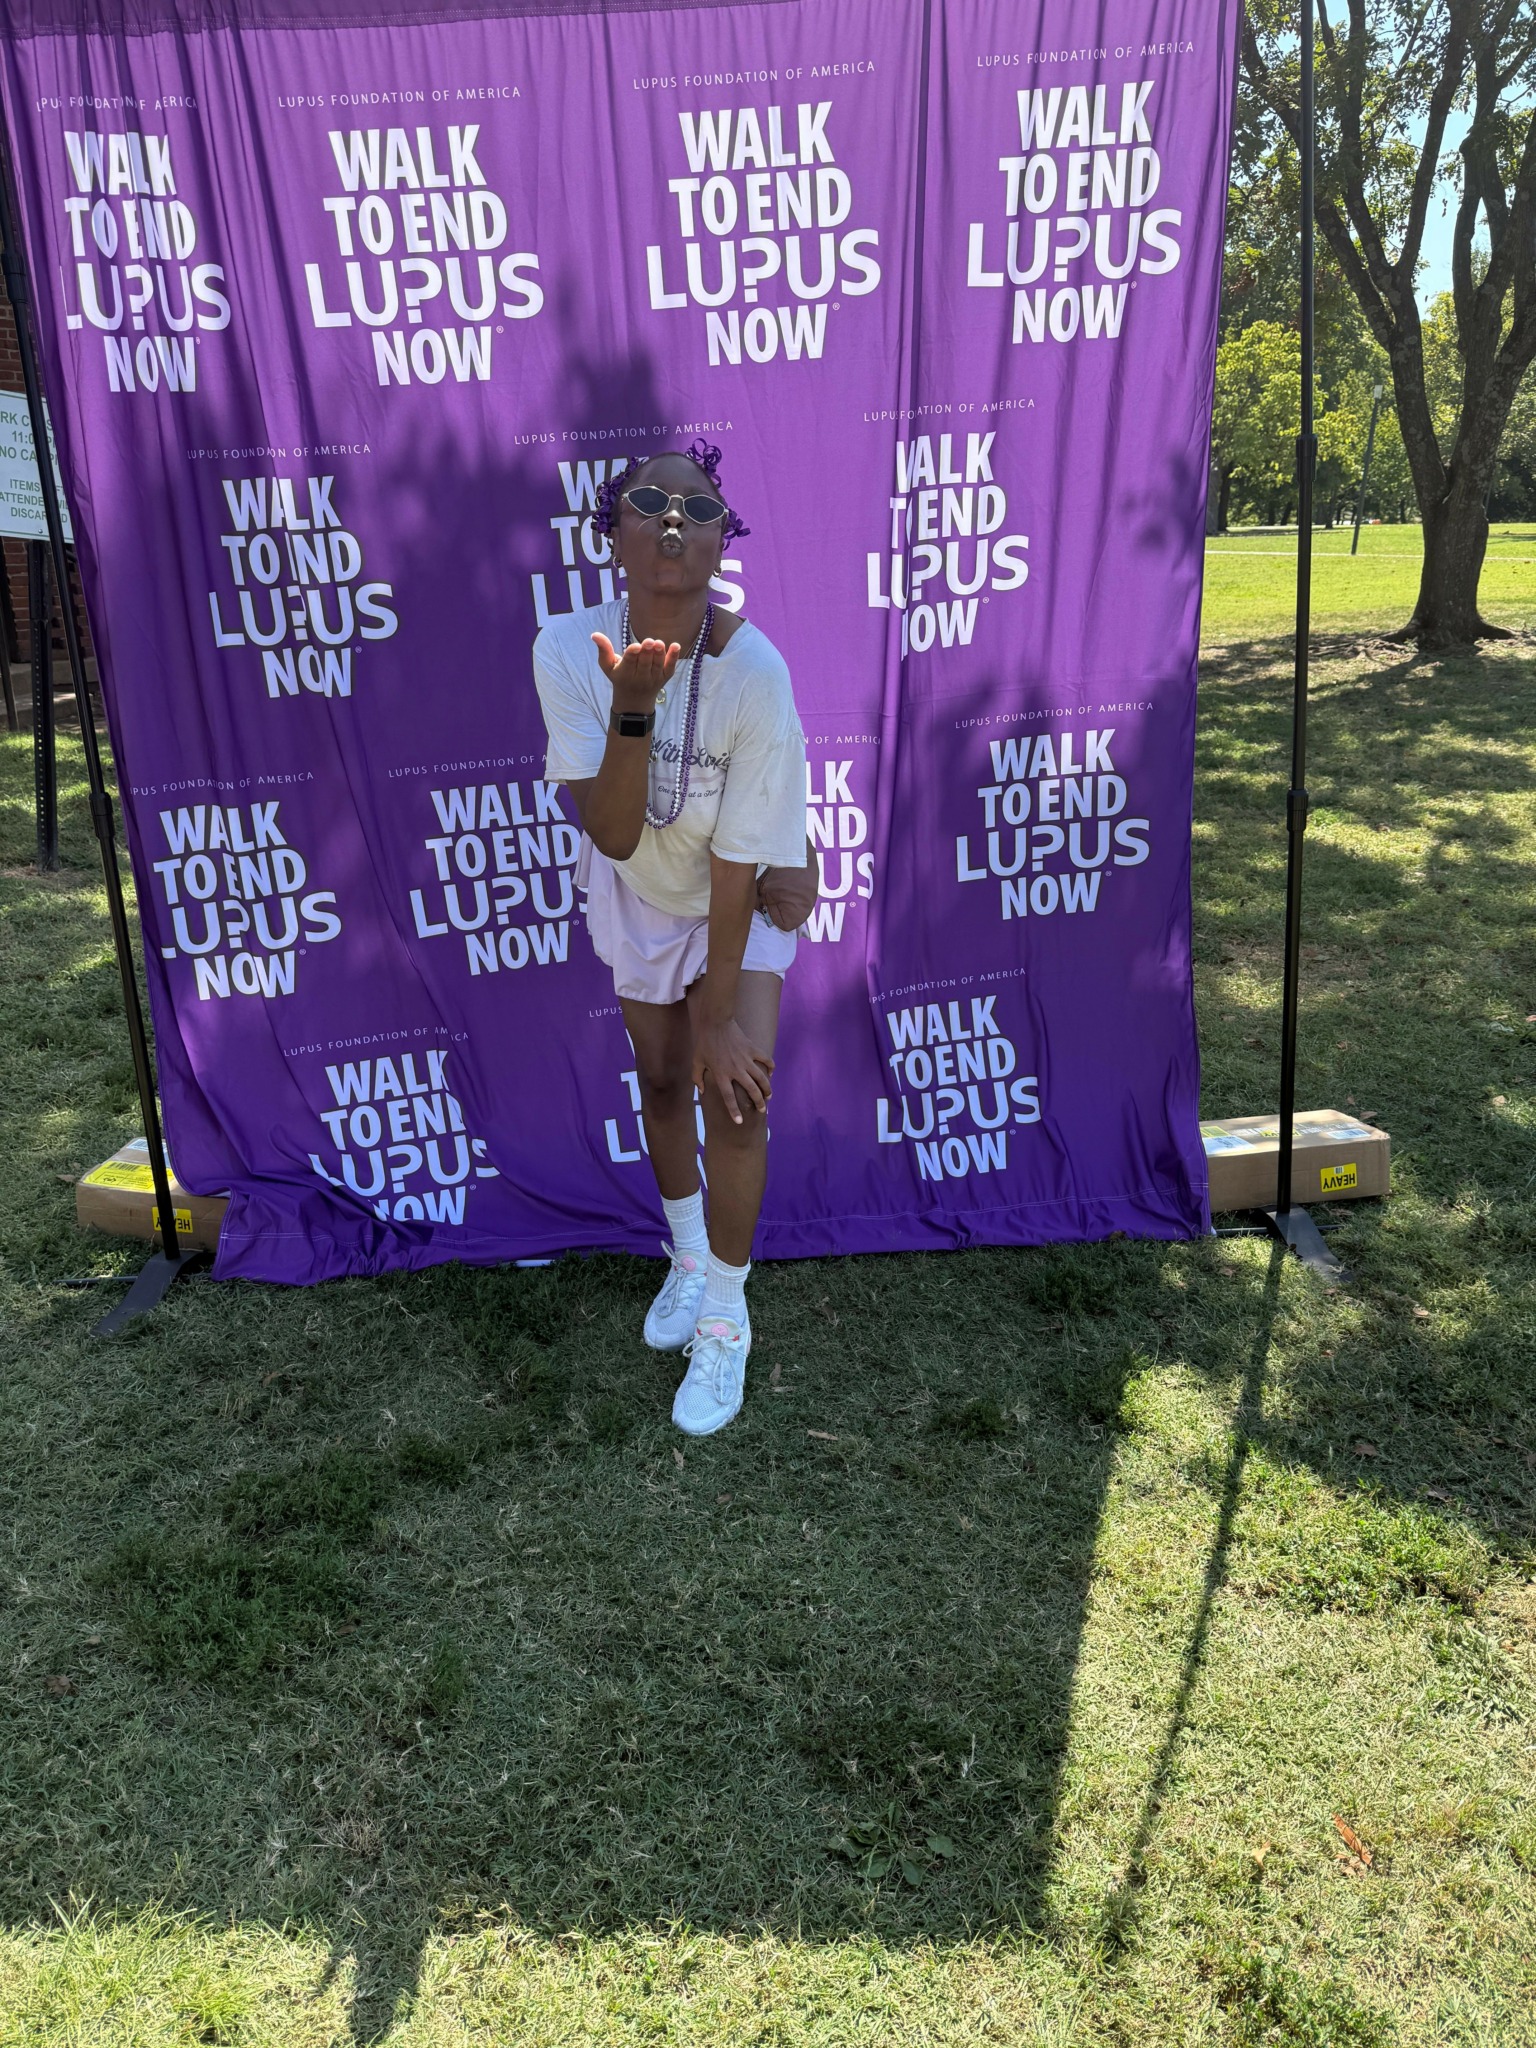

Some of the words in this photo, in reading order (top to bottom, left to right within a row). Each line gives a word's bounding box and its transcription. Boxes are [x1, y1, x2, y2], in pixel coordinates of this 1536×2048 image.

[634, 77, 677, 90] LUPUS
[685, 70, 778, 87] FOUNDATION
[786, 68, 802, 79] OF
[811, 61, 875, 77] AMERICA
[977, 55, 1019, 67] LUPUS
[1027, 48, 1107, 64] FOUNDATION
[1115, 47, 1132, 58] OF
[1140, 42, 1194, 57] AMERICA
[278, 96, 324, 107] LUPUS
[331, 91, 424, 105] FOUNDATION
[432, 90, 450, 101] OF
[456, 87, 521, 100] AMERICA
[1017, 81, 1155, 151] WALK
[64, 130, 176, 196] WALK
[328, 125, 487, 191] WALK
[678, 101, 835, 173] WALK
[668, 176, 738, 237] TO
[746, 168, 852, 232] END
[999, 154, 1057, 216] TO
[1066, 147, 1160, 212] END
[64, 197, 118, 258] TO
[122, 199, 196, 260] END
[323, 195, 394, 256] TO
[400, 191, 507, 254] END
[959, 403, 974, 413] OF
[982, 399, 1035, 413] AMERICA
[294, 447, 309, 457] OF
[314, 444, 371, 456] AMERICA
[514, 433, 556, 445] LUPUS
[563, 427, 646, 441] FOUNDATION
[653, 426, 668, 435] OF
[675, 421, 733, 435] AMERICA
[10, 478, 40, 492] ITEMS
[222, 476, 342, 531] WALK
[918, 485, 1006, 540] END
[221, 533, 280, 585] TO
[285, 531, 361, 584] ND
[815, 736, 829, 744] OF
[956, 717, 990, 729] LUPUS
[996, 708, 1072, 723] FOUNDATION
[1078, 706, 1092, 714] OF
[1099, 702, 1153, 713] AMERICA
[240, 778, 251, 788] OF
[258, 772, 314, 784] AMERICA
[389, 766, 427, 778] LUPUS
[434, 758, 514, 772] FOUNDATION
[521, 756, 535, 764] OF
[990, 729, 1116, 782] WALK
[159, 801, 287, 855] WALK
[430, 780, 566, 833] WALK
[806, 806, 867, 848] ND
[978, 783, 1031, 828] TO
[1039, 775, 1127, 821] END
[153, 854, 217, 905] TO
[222, 849, 306, 900] END
[425, 834, 486, 882] TO
[492, 824, 582, 873] END
[890, 979, 956, 997] FOUNDATION
[961, 976, 974, 984] OF
[980, 968, 1025, 981] AMERICA
[284, 1044, 322, 1057] LUPUS
[329, 1030, 408, 1049] FOUNDATION
[414, 1028, 428, 1036] OF
[887, 995, 1000, 1050] WALK
[325, 1050, 449, 1107] WALK
[889, 1049, 932, 1092] TO
[934, 1038, 1016, 1086] END
[320, 1106, 381, 1150] TO
[1323, 1173, 1355, 1189] HEAVY
